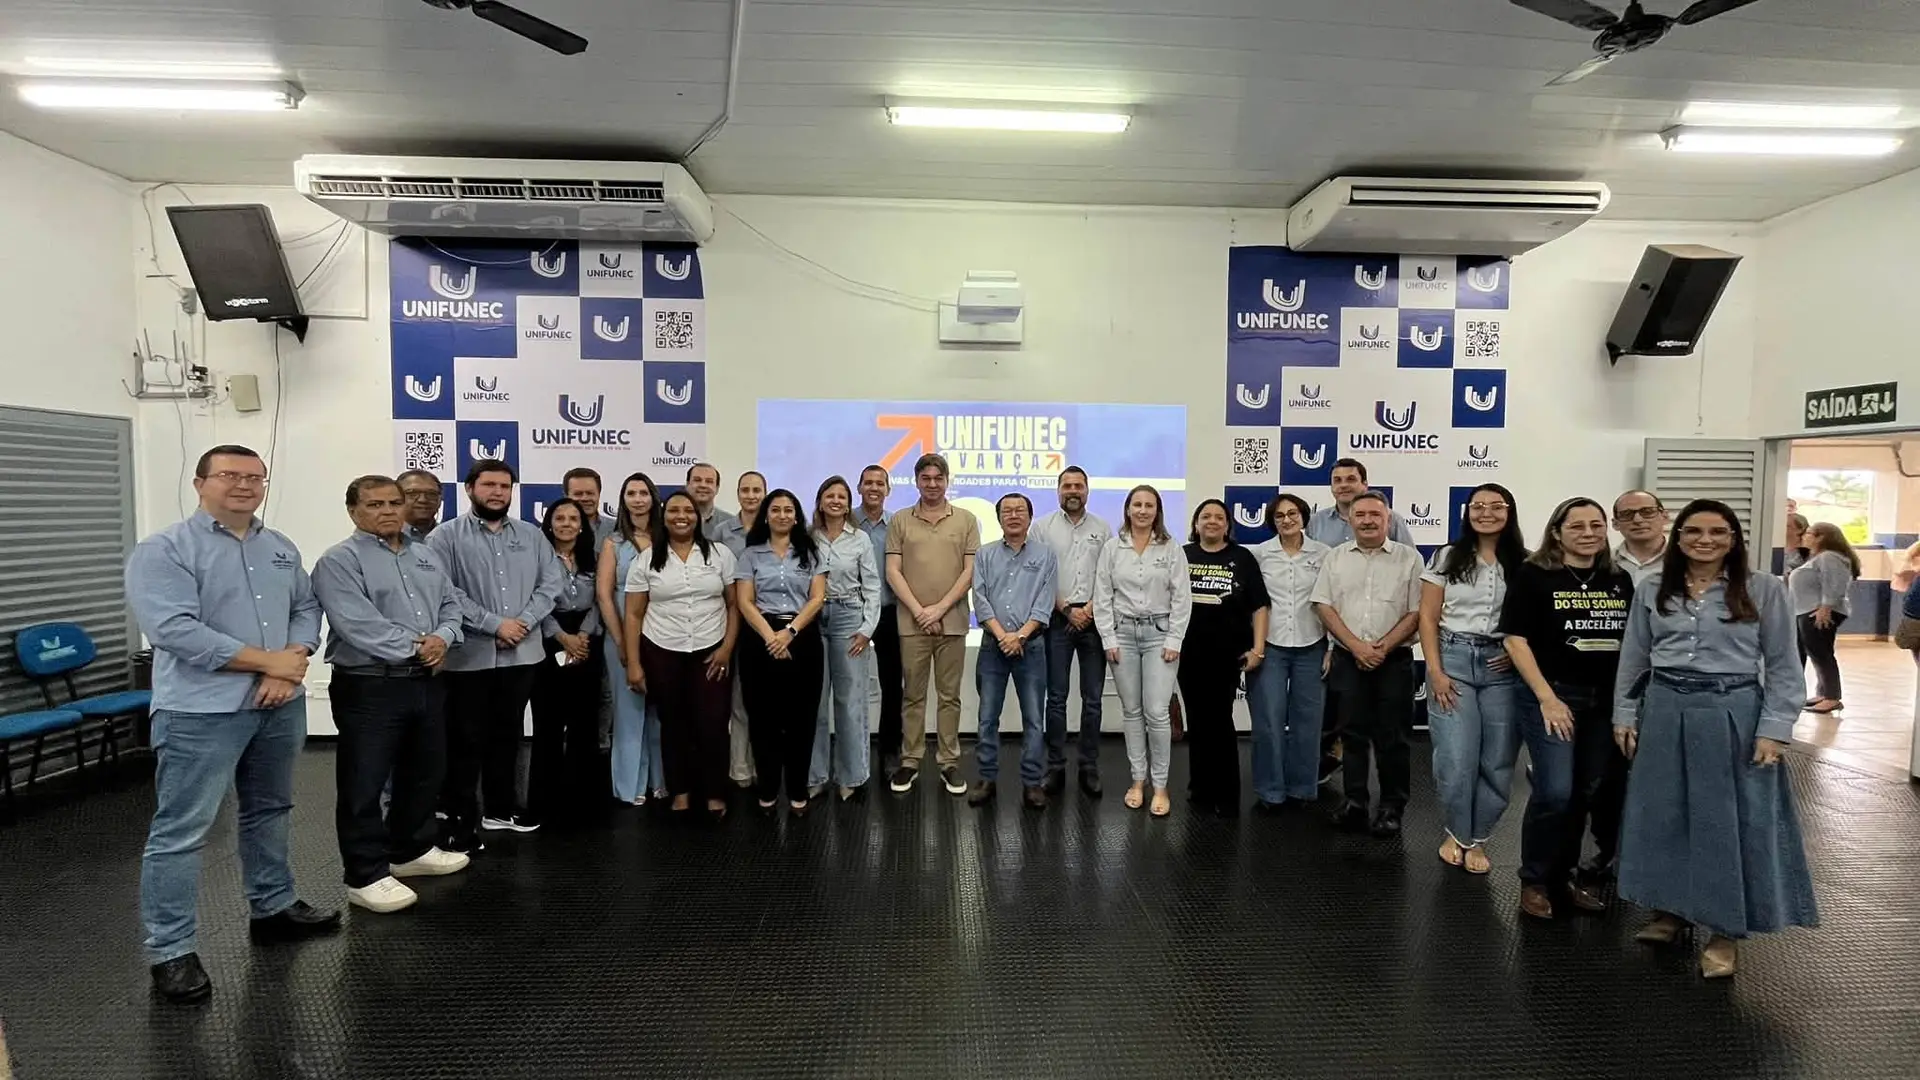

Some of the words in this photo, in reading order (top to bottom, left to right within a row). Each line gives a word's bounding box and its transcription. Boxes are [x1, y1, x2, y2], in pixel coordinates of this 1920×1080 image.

[587, 269, 634, 278] UNIFUNEC
[402, 300, 504, 319] UNIFUNEC
[1237, 312, 1329, 330] UNIFUNEC
[525, 330, 572, 339] UNIFUNEC
[1348, 340, 1391, 349] UNIFUNEC
[463, 392, 510, 401] UNIFUNEC
[1288, 399, 1332, 408] UNIFUNEC
[1807, 392, 1857, 421] SAÍDA
[532, 428, 631, 446] UNIFUNEC
[936, 415, 1066, 451] UNIFUNEC
[1350, 433, 1439, 449] UNIFUNEC
[652, 457, 698, 465] UNIFUNEC
[1457, 460, 1499, 468] UNIFUNEC
[993, 477, 1018, 486] PARA
[1404, 518, 1441, 526] NIFUNEC
[1191, 579, 1232, 590] XCELÊNCIA
[1554, 599, 1571, 610] DO
[1571, 599, 1590, 609] SEU
[1592, 599, 1626, 609] SONHO
[1564, 620, 1573, 630] A
[1575, 617, 1626, 630] EXCELÊNC
